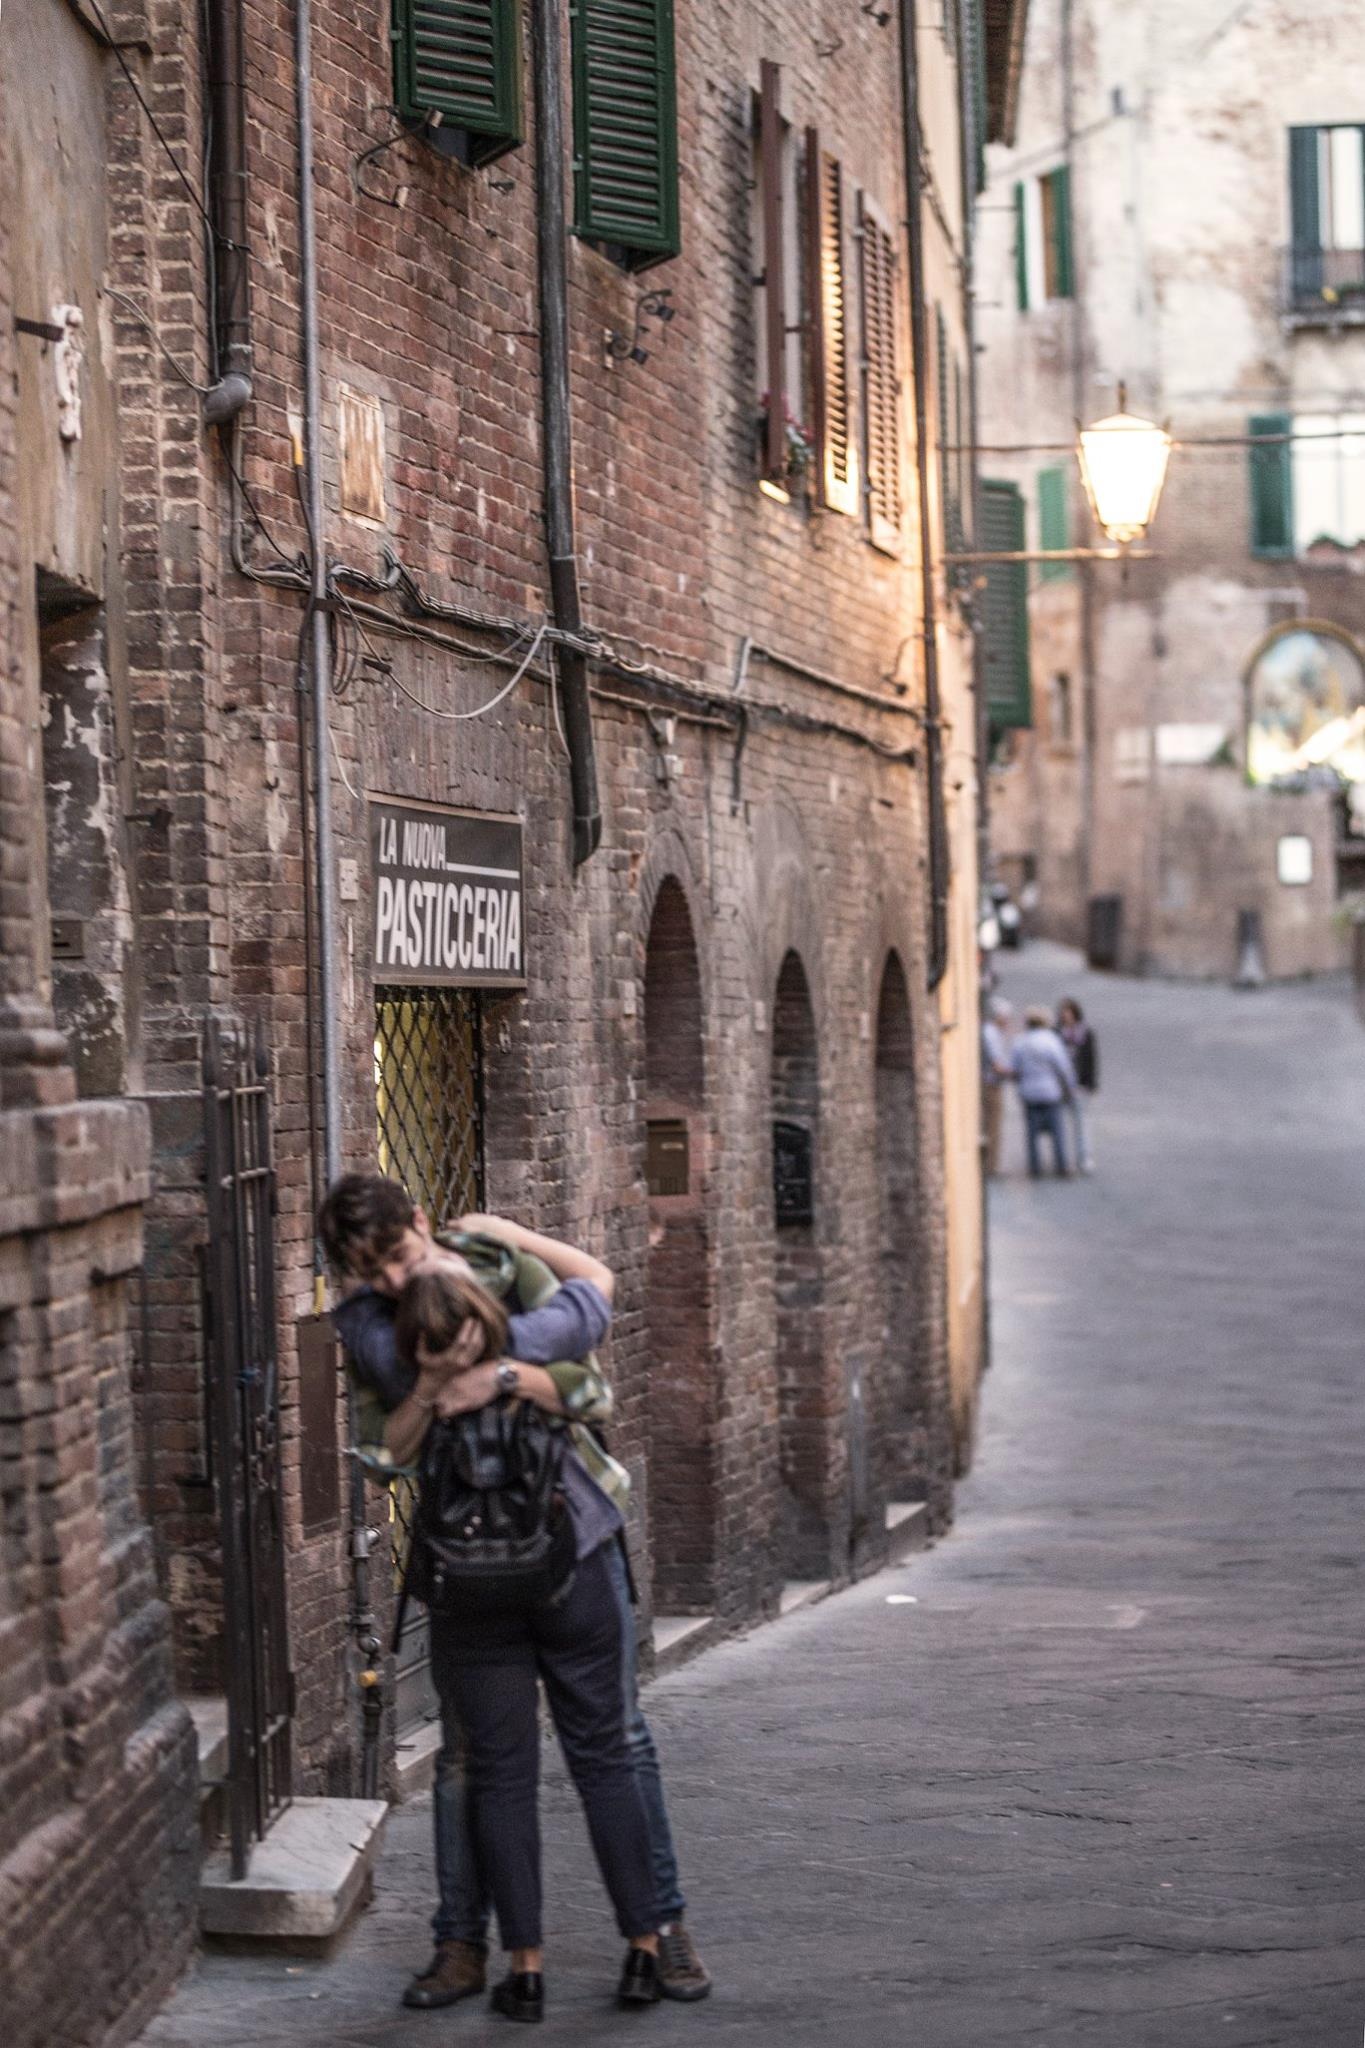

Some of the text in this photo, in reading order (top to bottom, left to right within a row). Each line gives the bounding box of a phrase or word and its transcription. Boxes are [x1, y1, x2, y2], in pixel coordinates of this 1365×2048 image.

[379, 817, 446, 870] LA NUOVA
[375, 876, 520, 969] PASTICCERIA
